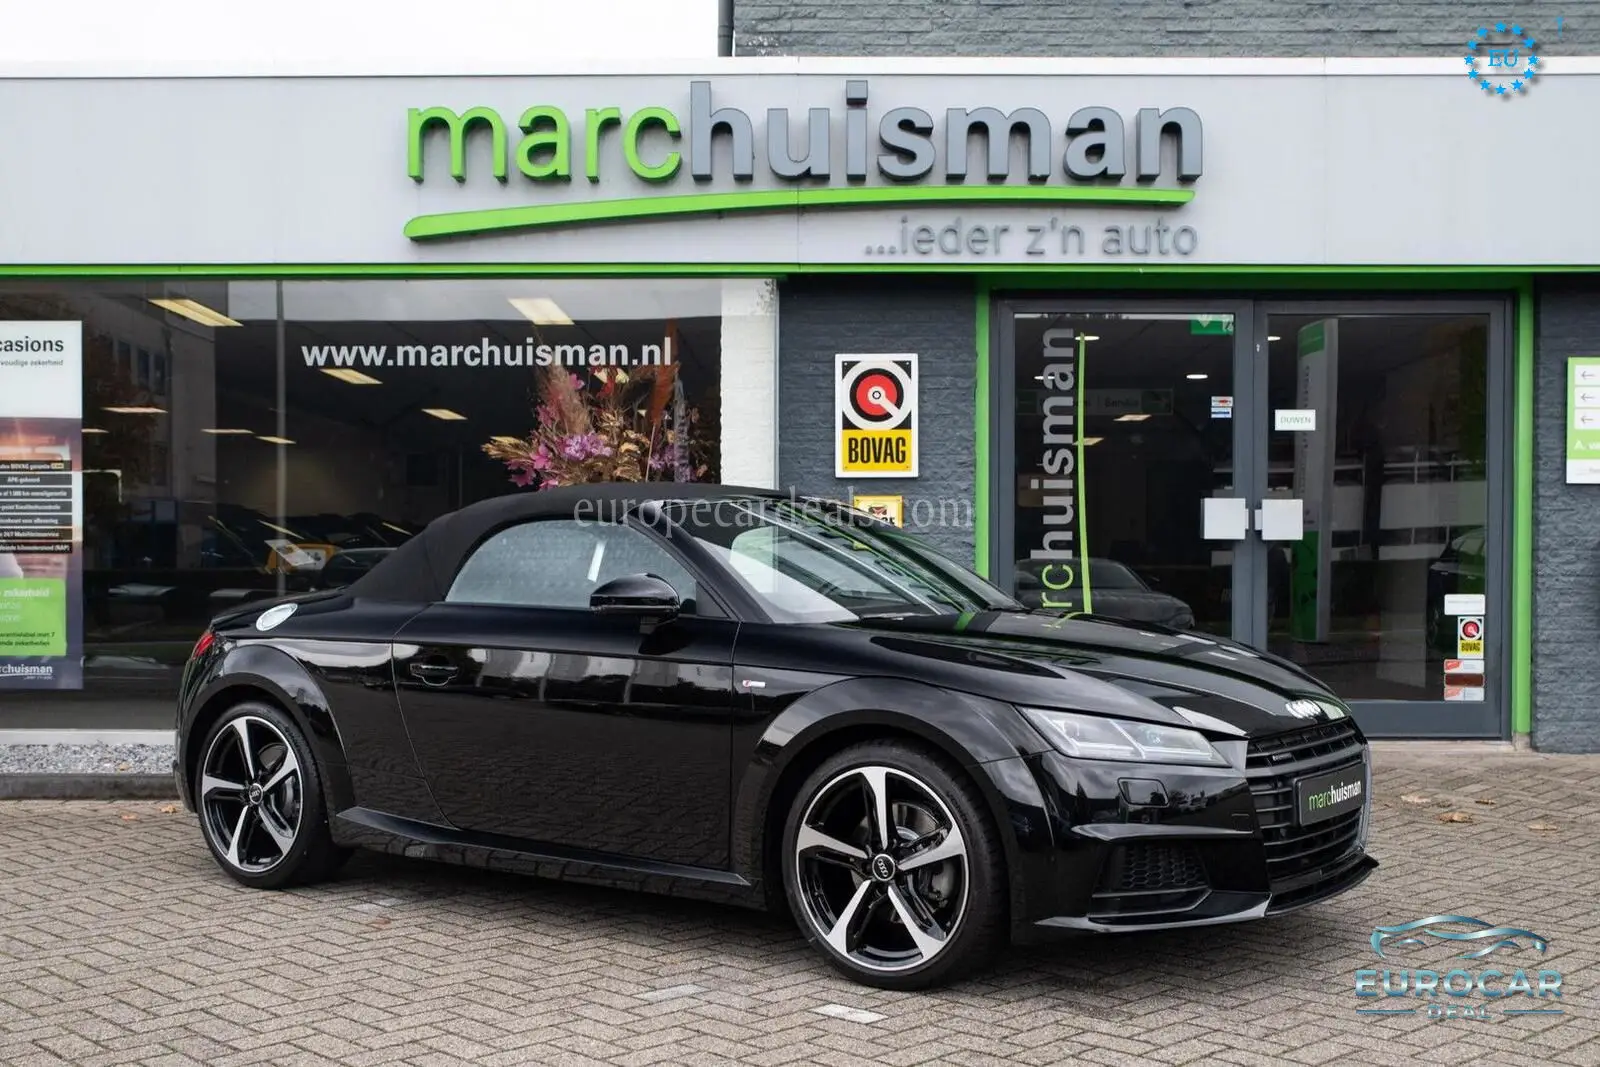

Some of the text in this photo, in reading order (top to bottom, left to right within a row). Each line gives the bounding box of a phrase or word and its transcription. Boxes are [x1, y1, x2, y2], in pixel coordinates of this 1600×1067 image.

[408, 80, 1203, 183] marchuisman
[865, 216, 1199, 255] ...ieder z'n auto
[0, 335, 64, 352] asions
[301, 336, 672, 367] www.marchuisman.nl
[848, 437, 906, 464] BOVAG
[1030, 328, 1074, 608] rchuisman
[1461, 642, 1481, 652] BOVAG
[1308, 780, 1362, 811] marchuisman
